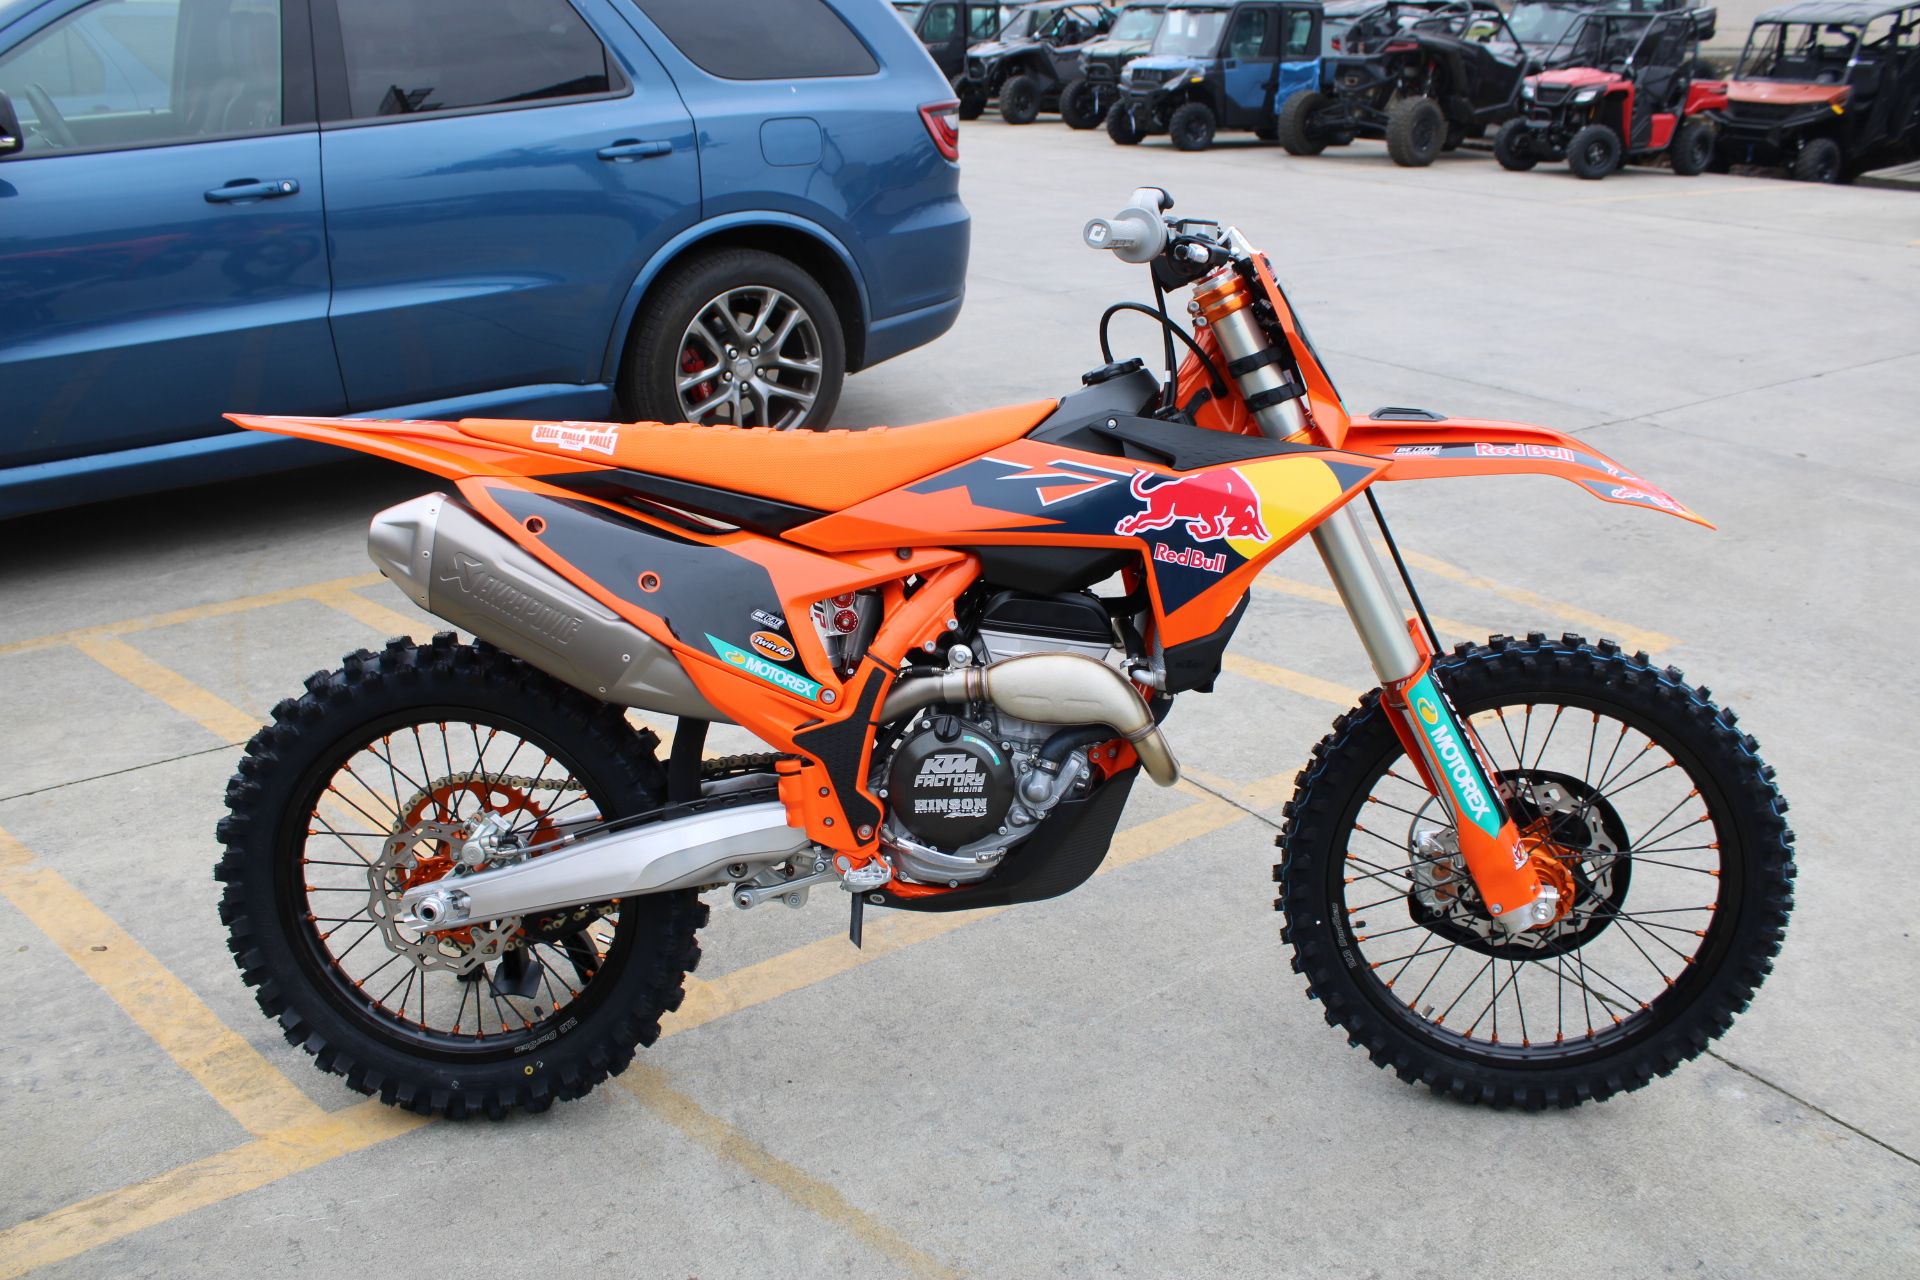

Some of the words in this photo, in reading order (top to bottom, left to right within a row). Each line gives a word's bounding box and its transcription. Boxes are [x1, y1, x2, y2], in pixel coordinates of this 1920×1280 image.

[536, 427, 560, 439] SELLE
[561, 431, 586, 443] DALLA
[588, 435, 614, 449] VALLE
[1475, 442, 1526, 457] Red
[1525, 444, 1575, 462] Bull
[1153, 542, 1191, 567] Red
[1189, 550, 1227, 574] Bull
[754, 635, 777, 651] Twin
[775, 645, 792, 657] Air
[745, 656, 816, 697] MOTOREX
[920, 753, 978, 774] KTM
[1430, 724, 1491, 821] MOTOREX
[913, 772, 987, 788] FACTORY
[914, 797, 988, 811] HINSON
